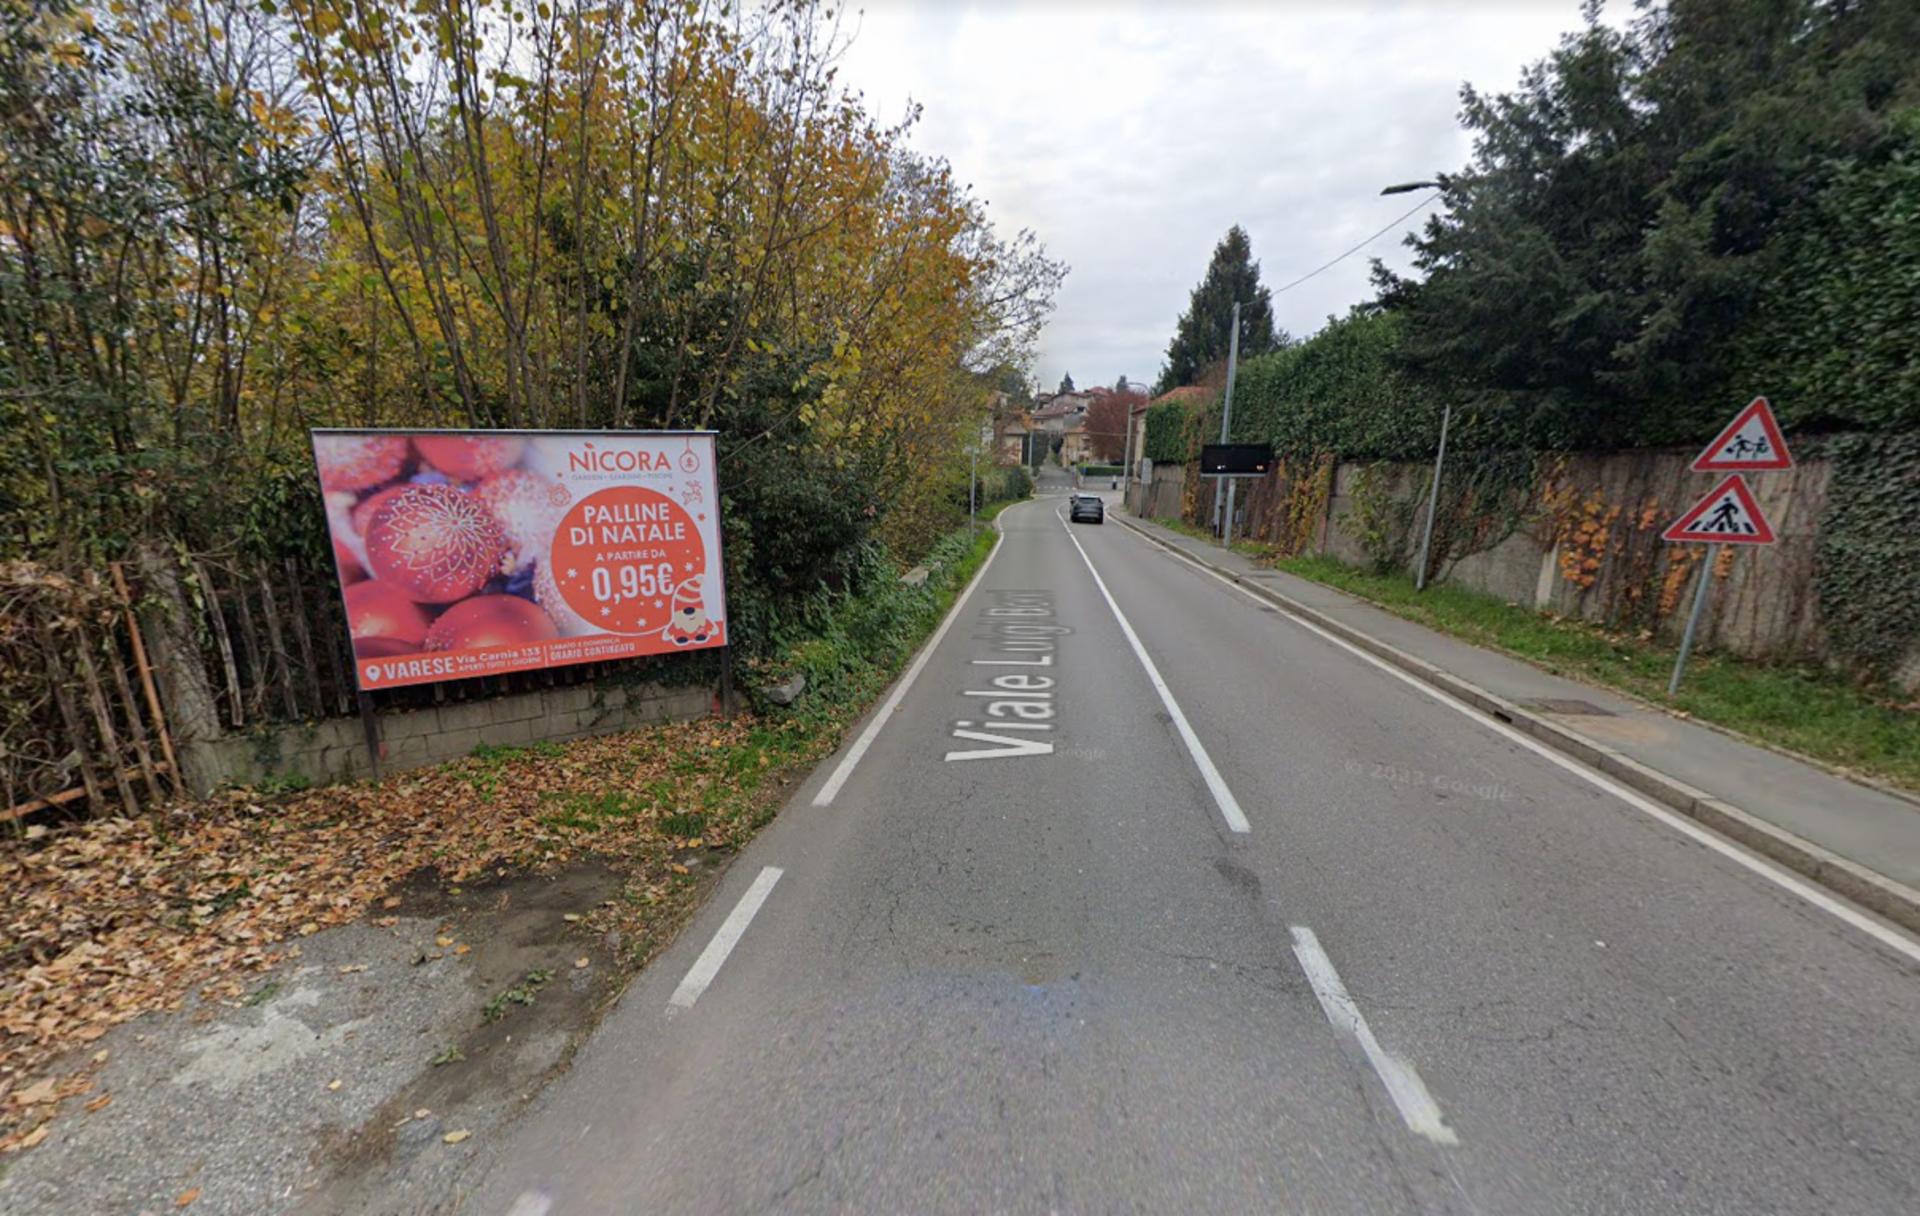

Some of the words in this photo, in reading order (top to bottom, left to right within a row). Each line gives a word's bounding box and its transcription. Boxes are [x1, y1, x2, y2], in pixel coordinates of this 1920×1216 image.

[584, 503, 670, 524] PALLINE
[570, 526, 594, 546] DI
[602, 522, 685, 545] NATALE
[596, 552, 605, 562] A
[607, 549, 649, 561] PARTIRE
[651, 548, 666, 559] DA
[592, 562, 675, 604] 0,95€
[383, 657, 455, 680] VARESE
[456, 655, 477, 664] Via
[480, 649, 519, 661] Carnia
